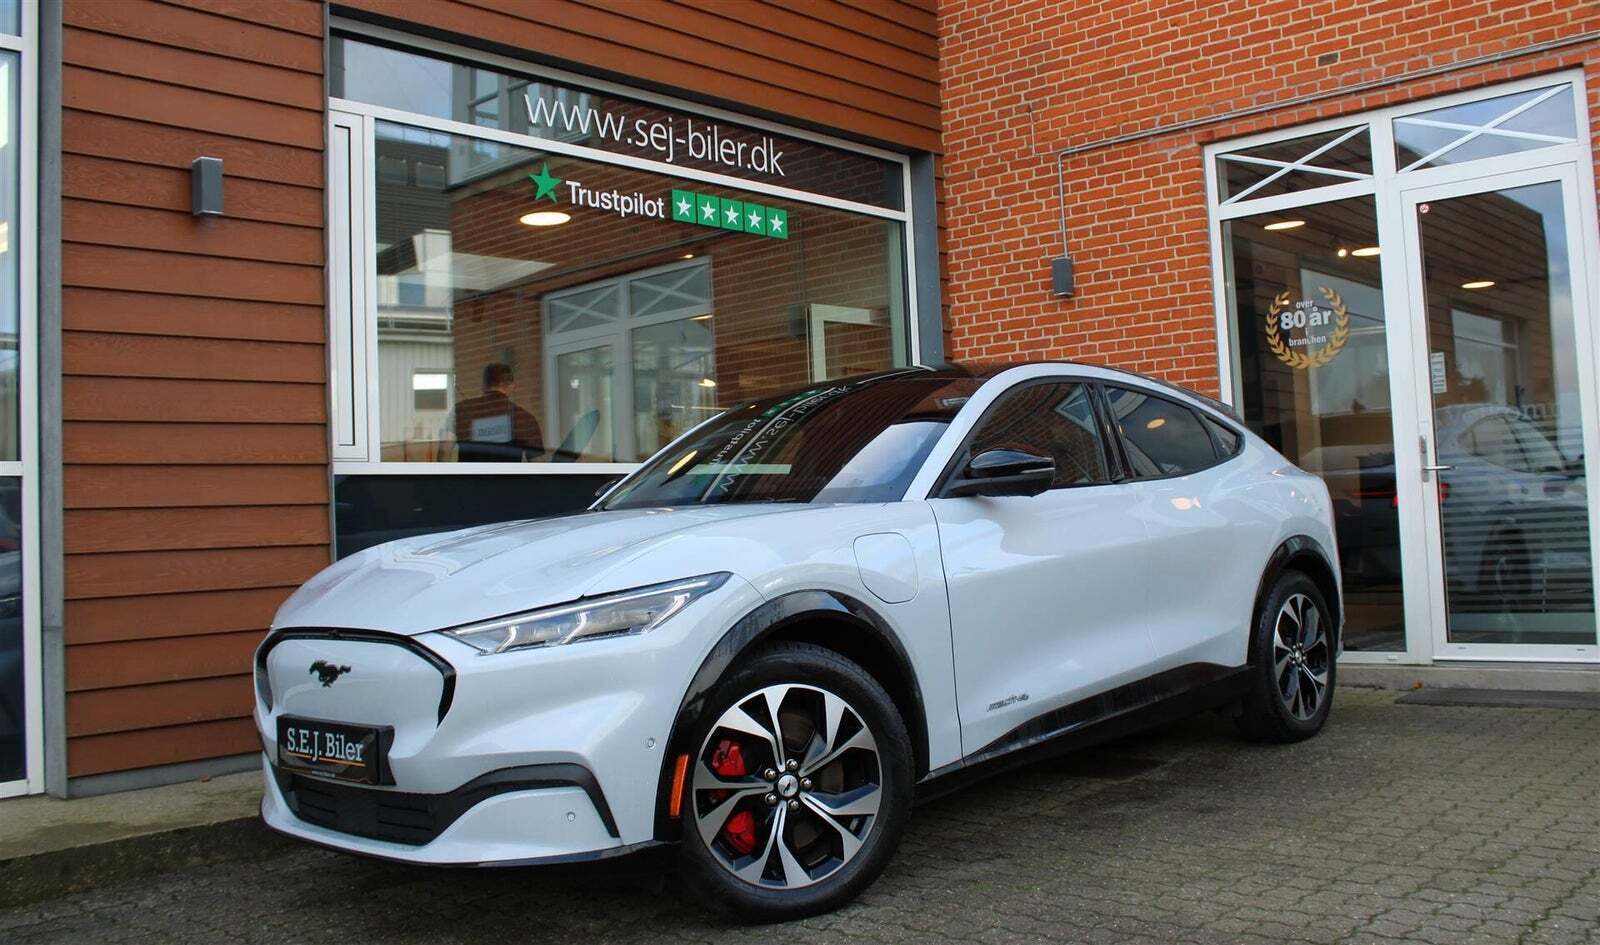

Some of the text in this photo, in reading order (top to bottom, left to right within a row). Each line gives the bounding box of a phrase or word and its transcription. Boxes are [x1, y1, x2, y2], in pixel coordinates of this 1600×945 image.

[524, 94, 785, 177] www.sej-biler.dk
[565, 180, 665, 219] Trustpilot
[1280, 306, 1332, 329] 80 år
[1296, 300, 1314, 309] over
[287, 727, 363, 762] S.E.J. Biler
